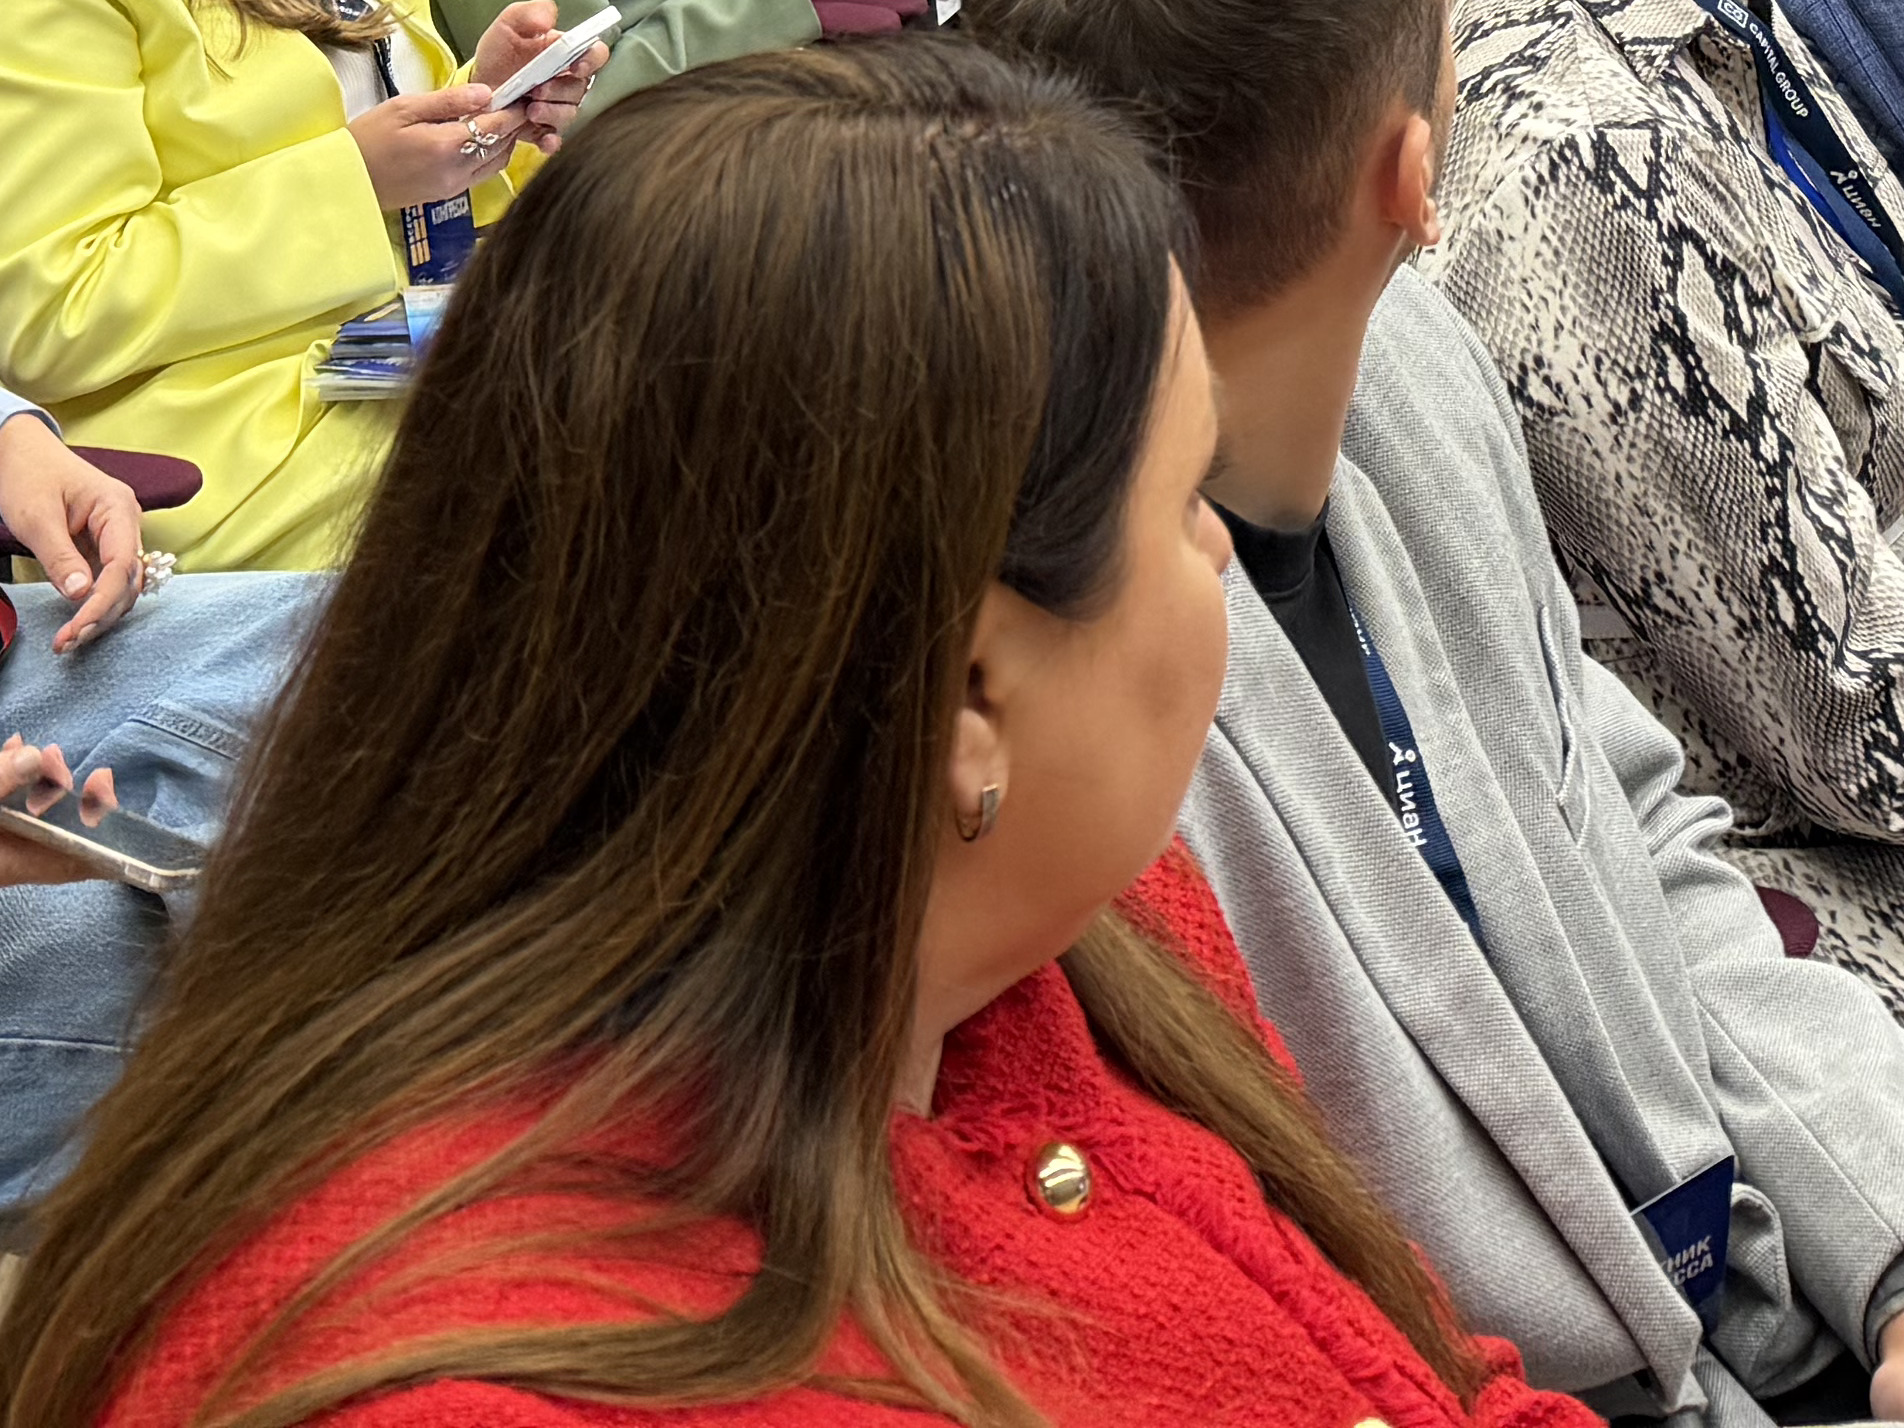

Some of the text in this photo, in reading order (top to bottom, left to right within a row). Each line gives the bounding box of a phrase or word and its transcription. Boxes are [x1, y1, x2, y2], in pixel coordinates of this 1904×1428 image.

[1749, 22, 1778, 75] CAPITAL
[1775, 72, 1809, 118] GROUP
[1397, 771, 1427, 847] циан
